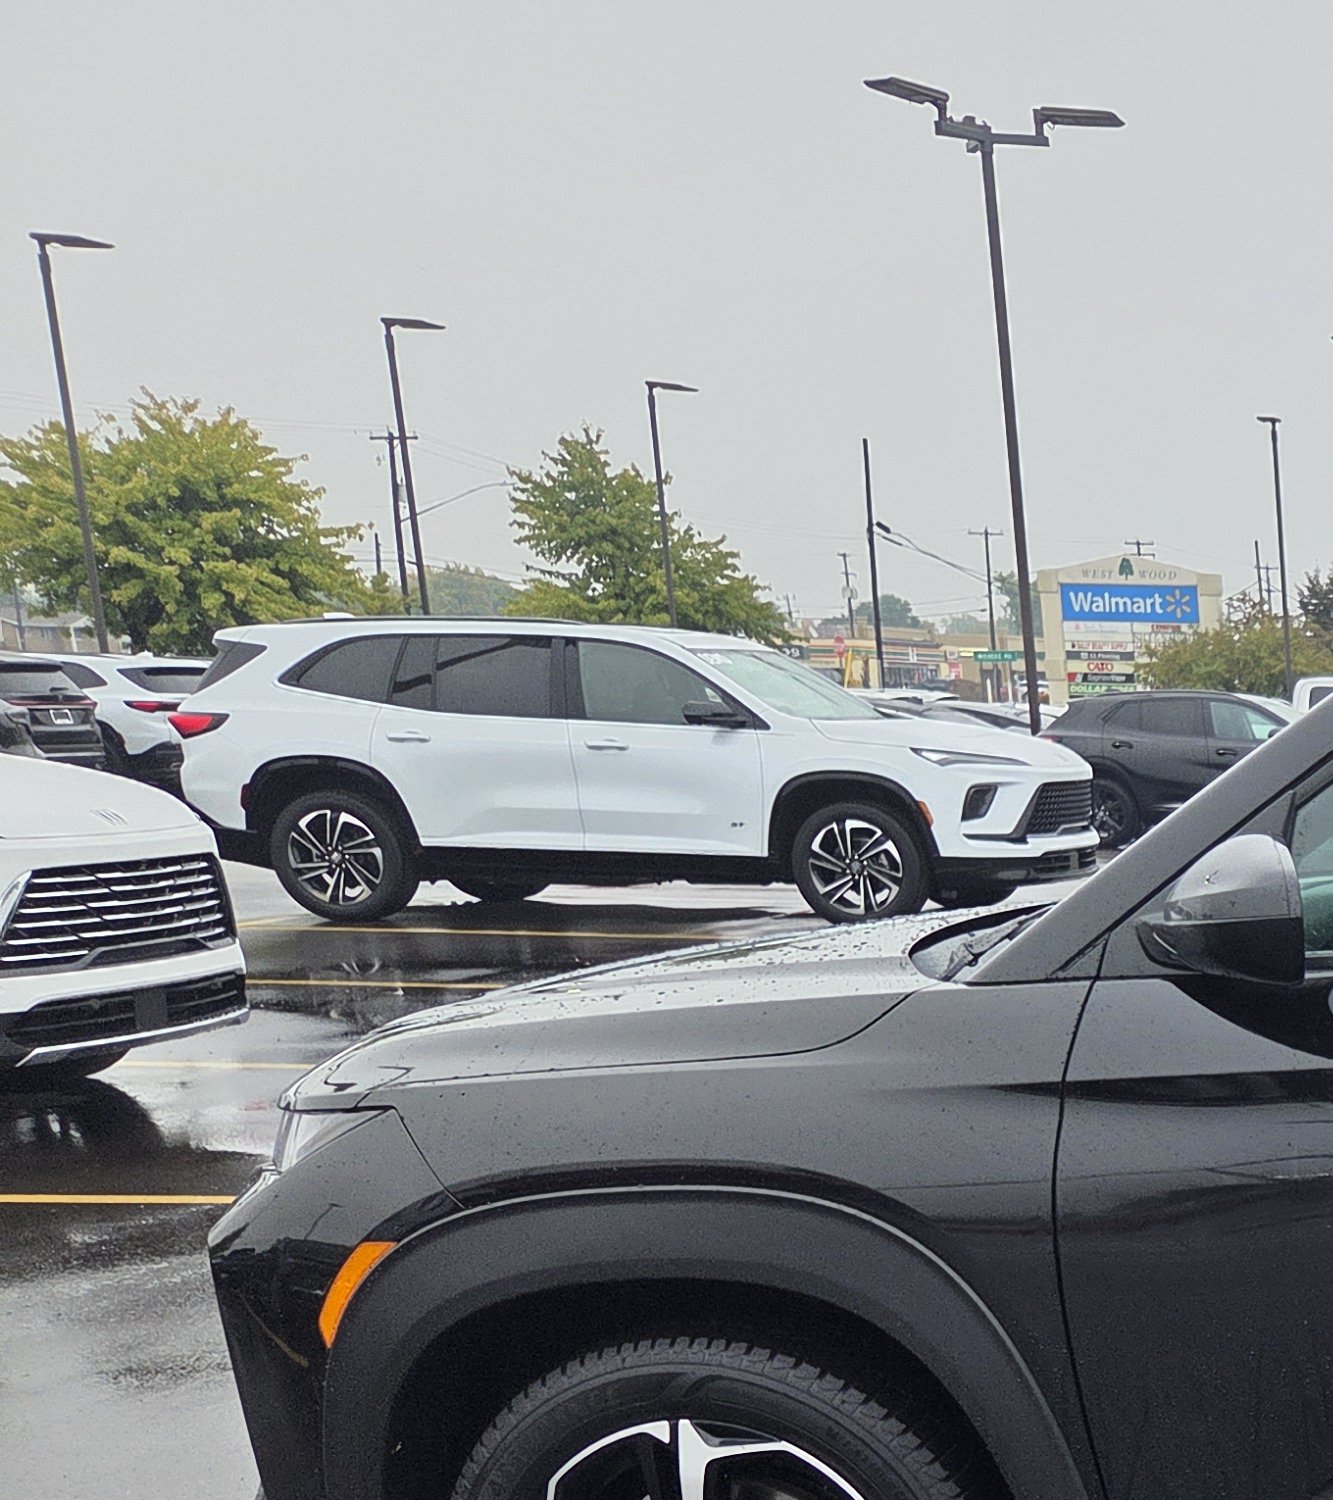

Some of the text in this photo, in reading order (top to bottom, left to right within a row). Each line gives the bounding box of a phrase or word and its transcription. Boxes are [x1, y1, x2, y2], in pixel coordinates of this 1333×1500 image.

[1081, 568, 1177, 580] WEST WOOD
[1068, 591, 1164, 614] Walmart
[1087, 662, 1114, 672] CATO
[1070, 684, 1108, 693] DOLLAR
